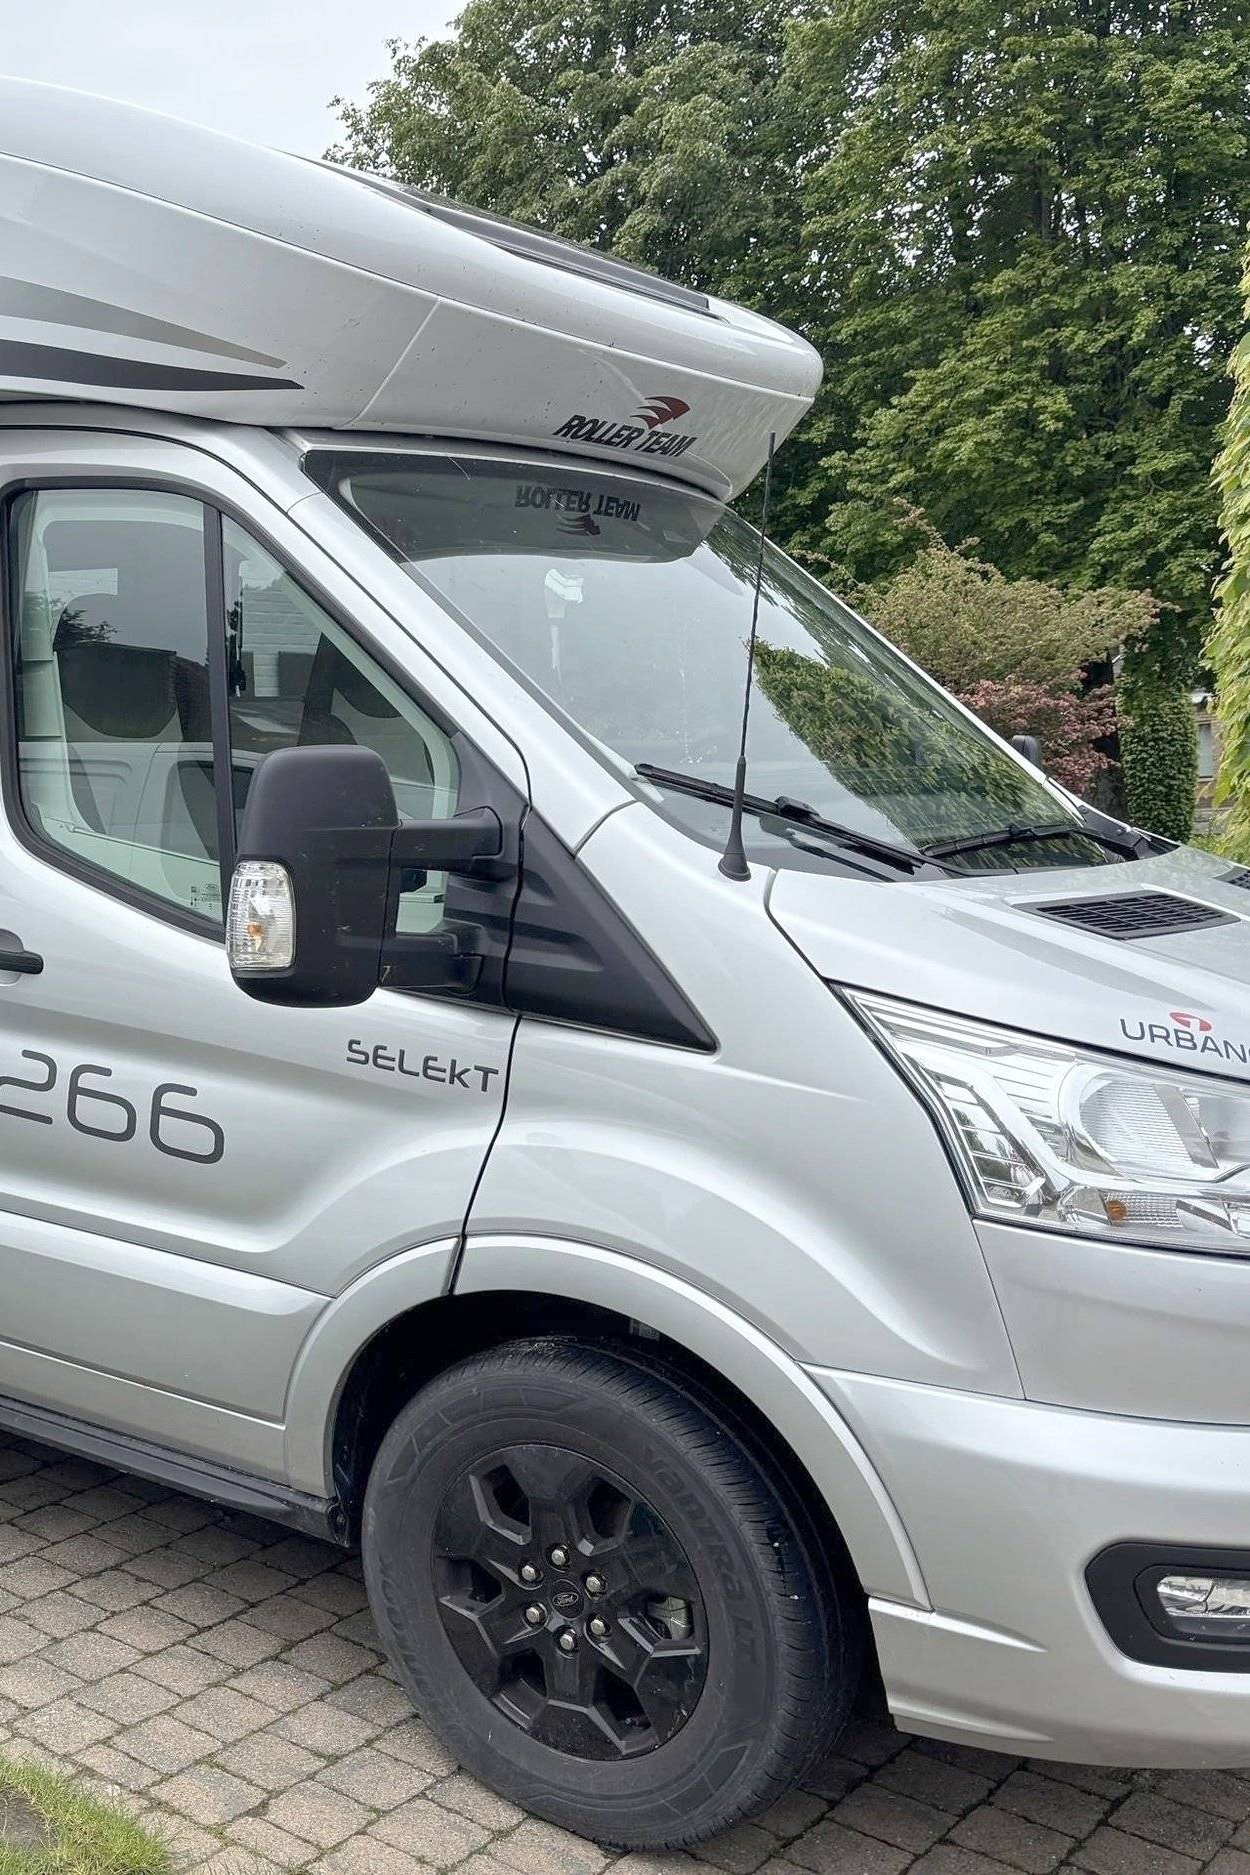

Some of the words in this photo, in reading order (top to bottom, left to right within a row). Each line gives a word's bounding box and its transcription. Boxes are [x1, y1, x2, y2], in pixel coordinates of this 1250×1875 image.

[552, 414, 645, 449] ROLLER
[634, 429, 698, 457] TEAM
[1120, 1018, 1250, 1064] URBAN
[347, 1039, 499, 1093] SELEKT
